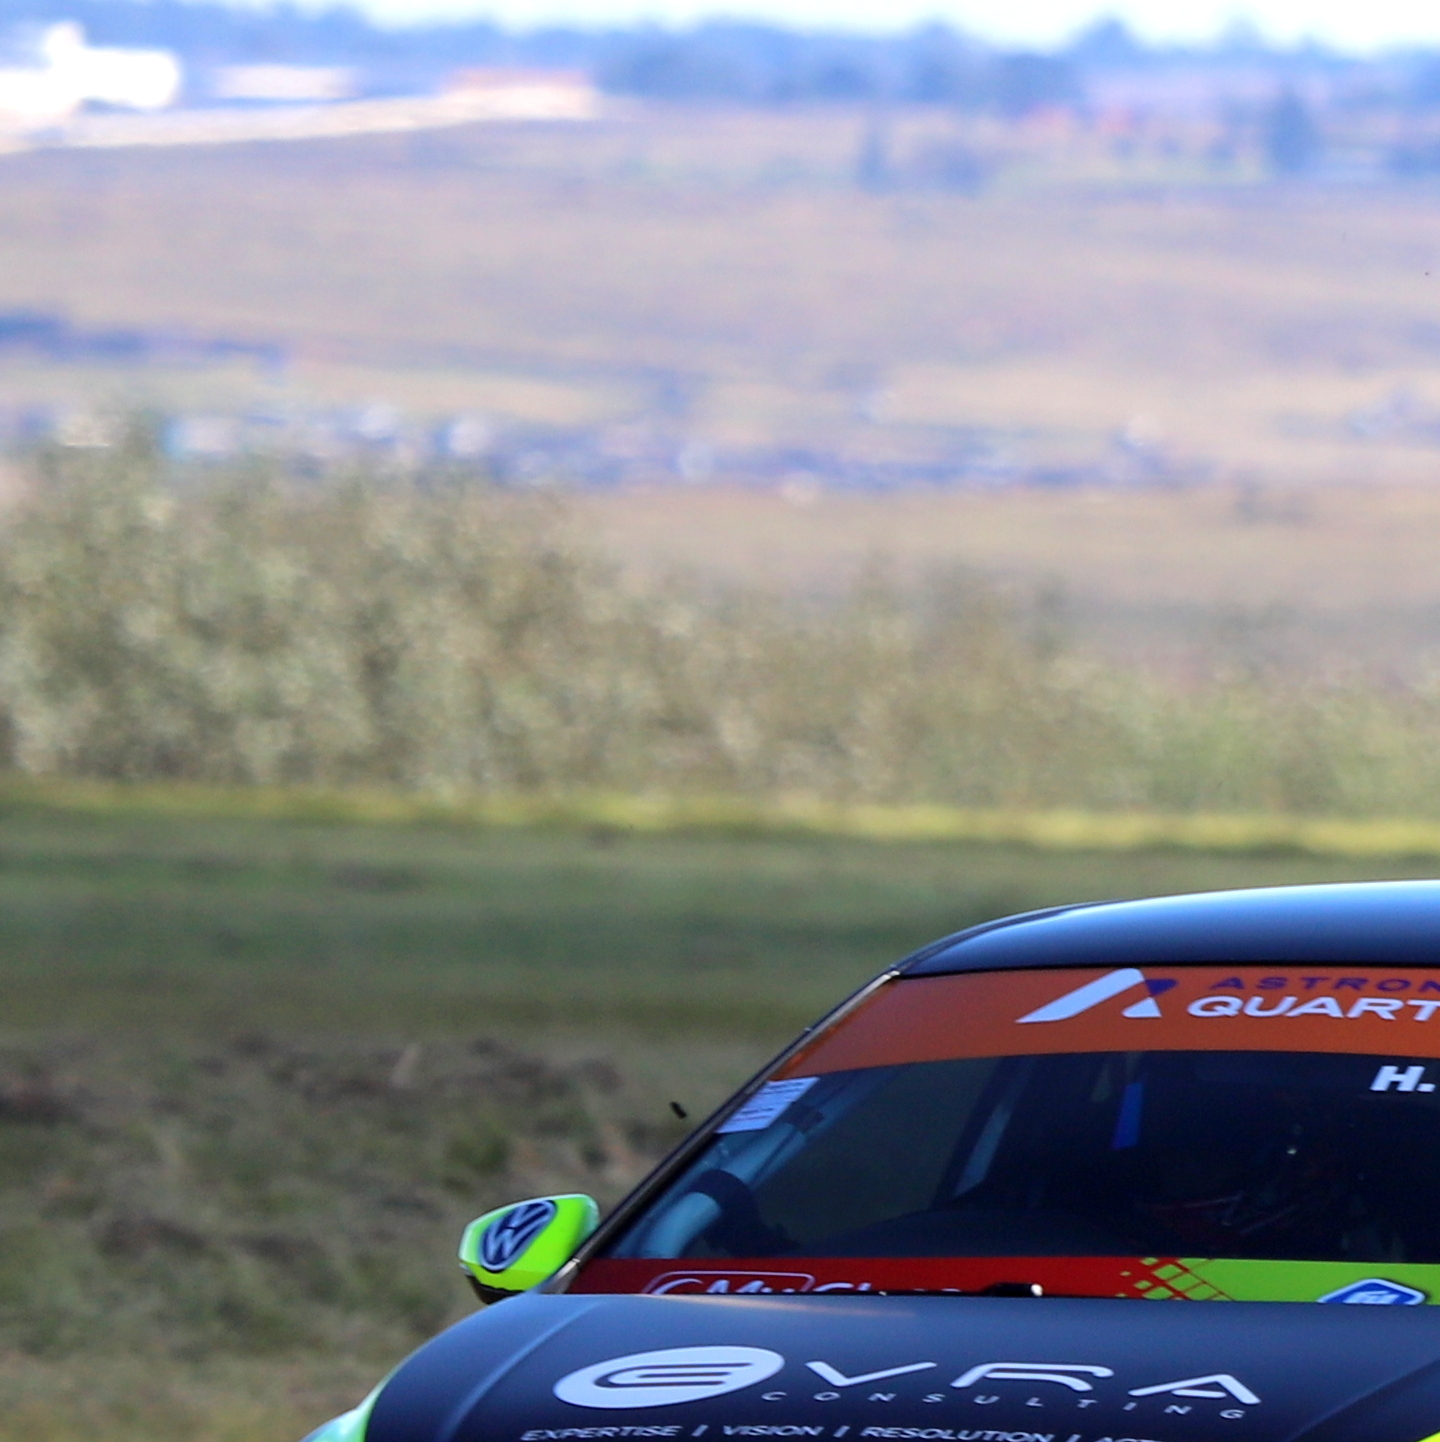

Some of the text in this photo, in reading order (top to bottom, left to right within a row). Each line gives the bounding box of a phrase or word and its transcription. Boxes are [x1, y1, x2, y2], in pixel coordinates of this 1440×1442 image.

[1371, 1066, 1435, 1093] H.
[761, 1391, 1246, 1419] CONSULTING
[520, 1425, 682, 1441] EXPERTISE
[723, 1425, 824, 1438] VISION
